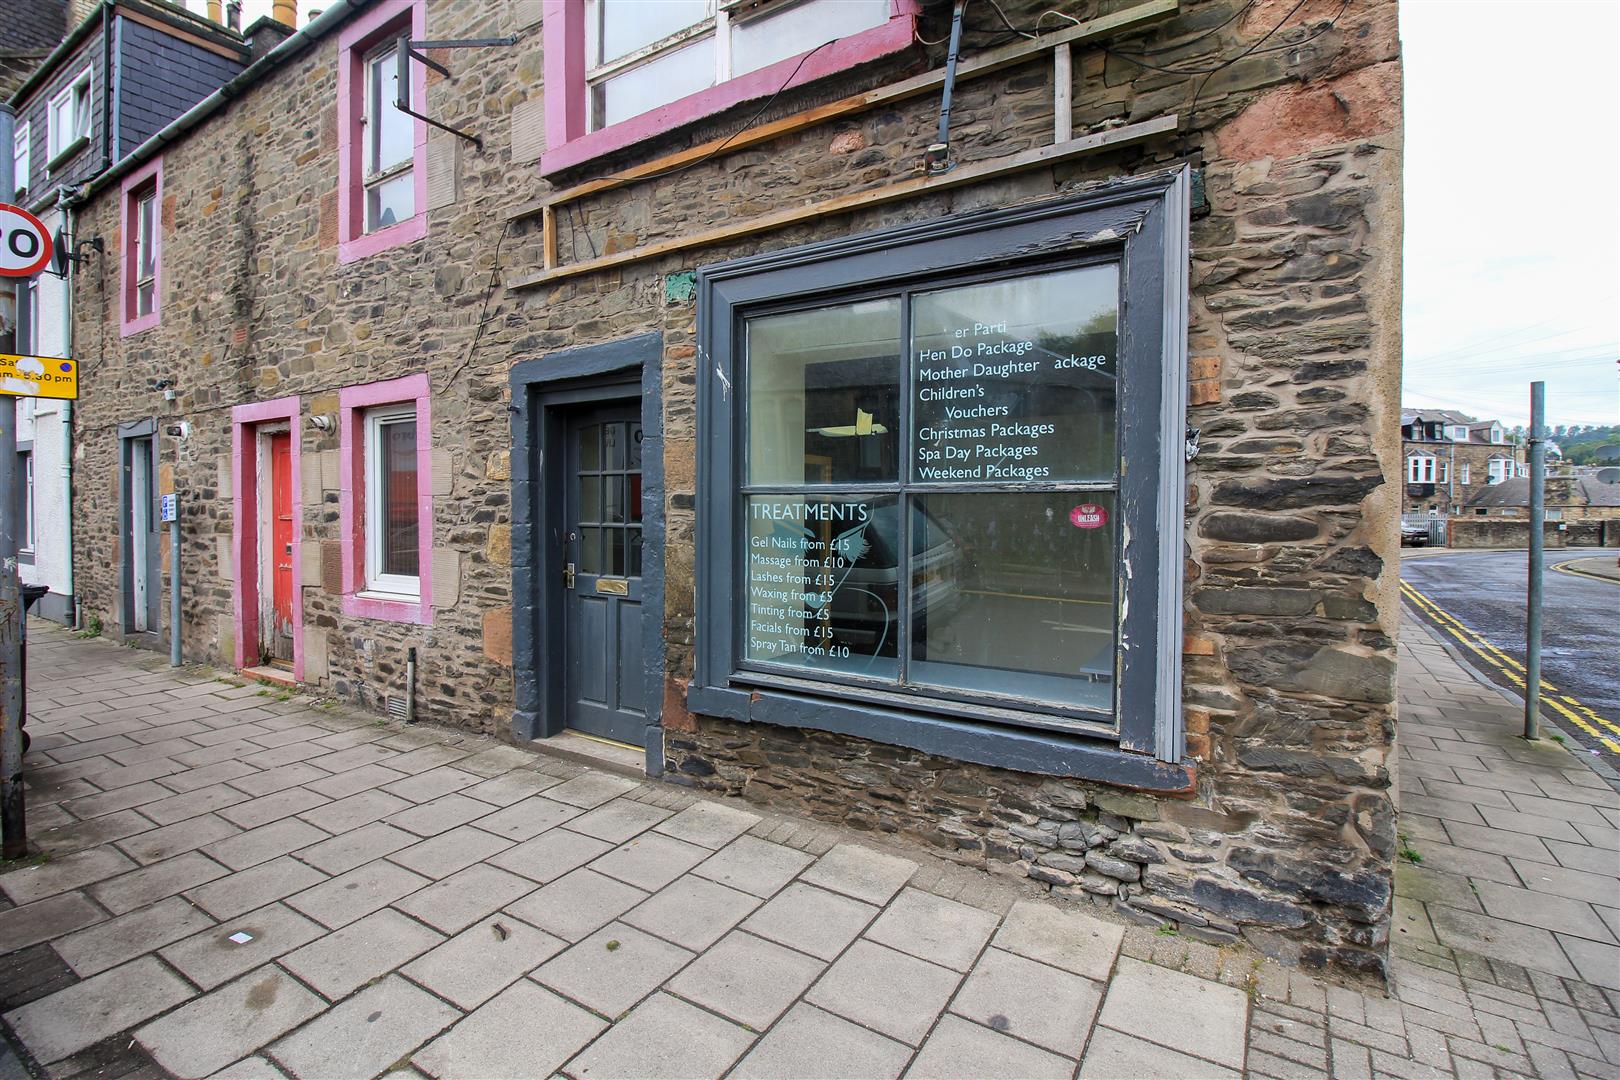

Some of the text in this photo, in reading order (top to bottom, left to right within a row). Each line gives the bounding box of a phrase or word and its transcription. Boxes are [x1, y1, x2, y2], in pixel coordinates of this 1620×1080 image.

[0, 228, 39, 258] 0
[920, 340, 1033, 362] Hen Do Package
[920, 354, 1106, 381] Mother Daughter ackage
[920, 384, 984, 402] Children's
[945, 405, 1008, 419] Vouchers
[919, 422, 1054, 441] Christmas Packages
[919, 444, 1038, 463] Spa Day Packages
[919, 464, 1049, 480] Weekend Packages
[750, 503, 868, 520] TREATMENTS
[751, 537, 850, 550] Gel Nails from £15
[751, 554, 844, 568] Massage from £10
[751, 572, 834, 586] Lashes from £15
[750, 586, 832, 602] Waxing from £5
[750, 602, 830, 620] Tinting from £5
[751, 620, 834, 638] Facials from £15
[750, 636, 850, 658] Spray Tan from £10
